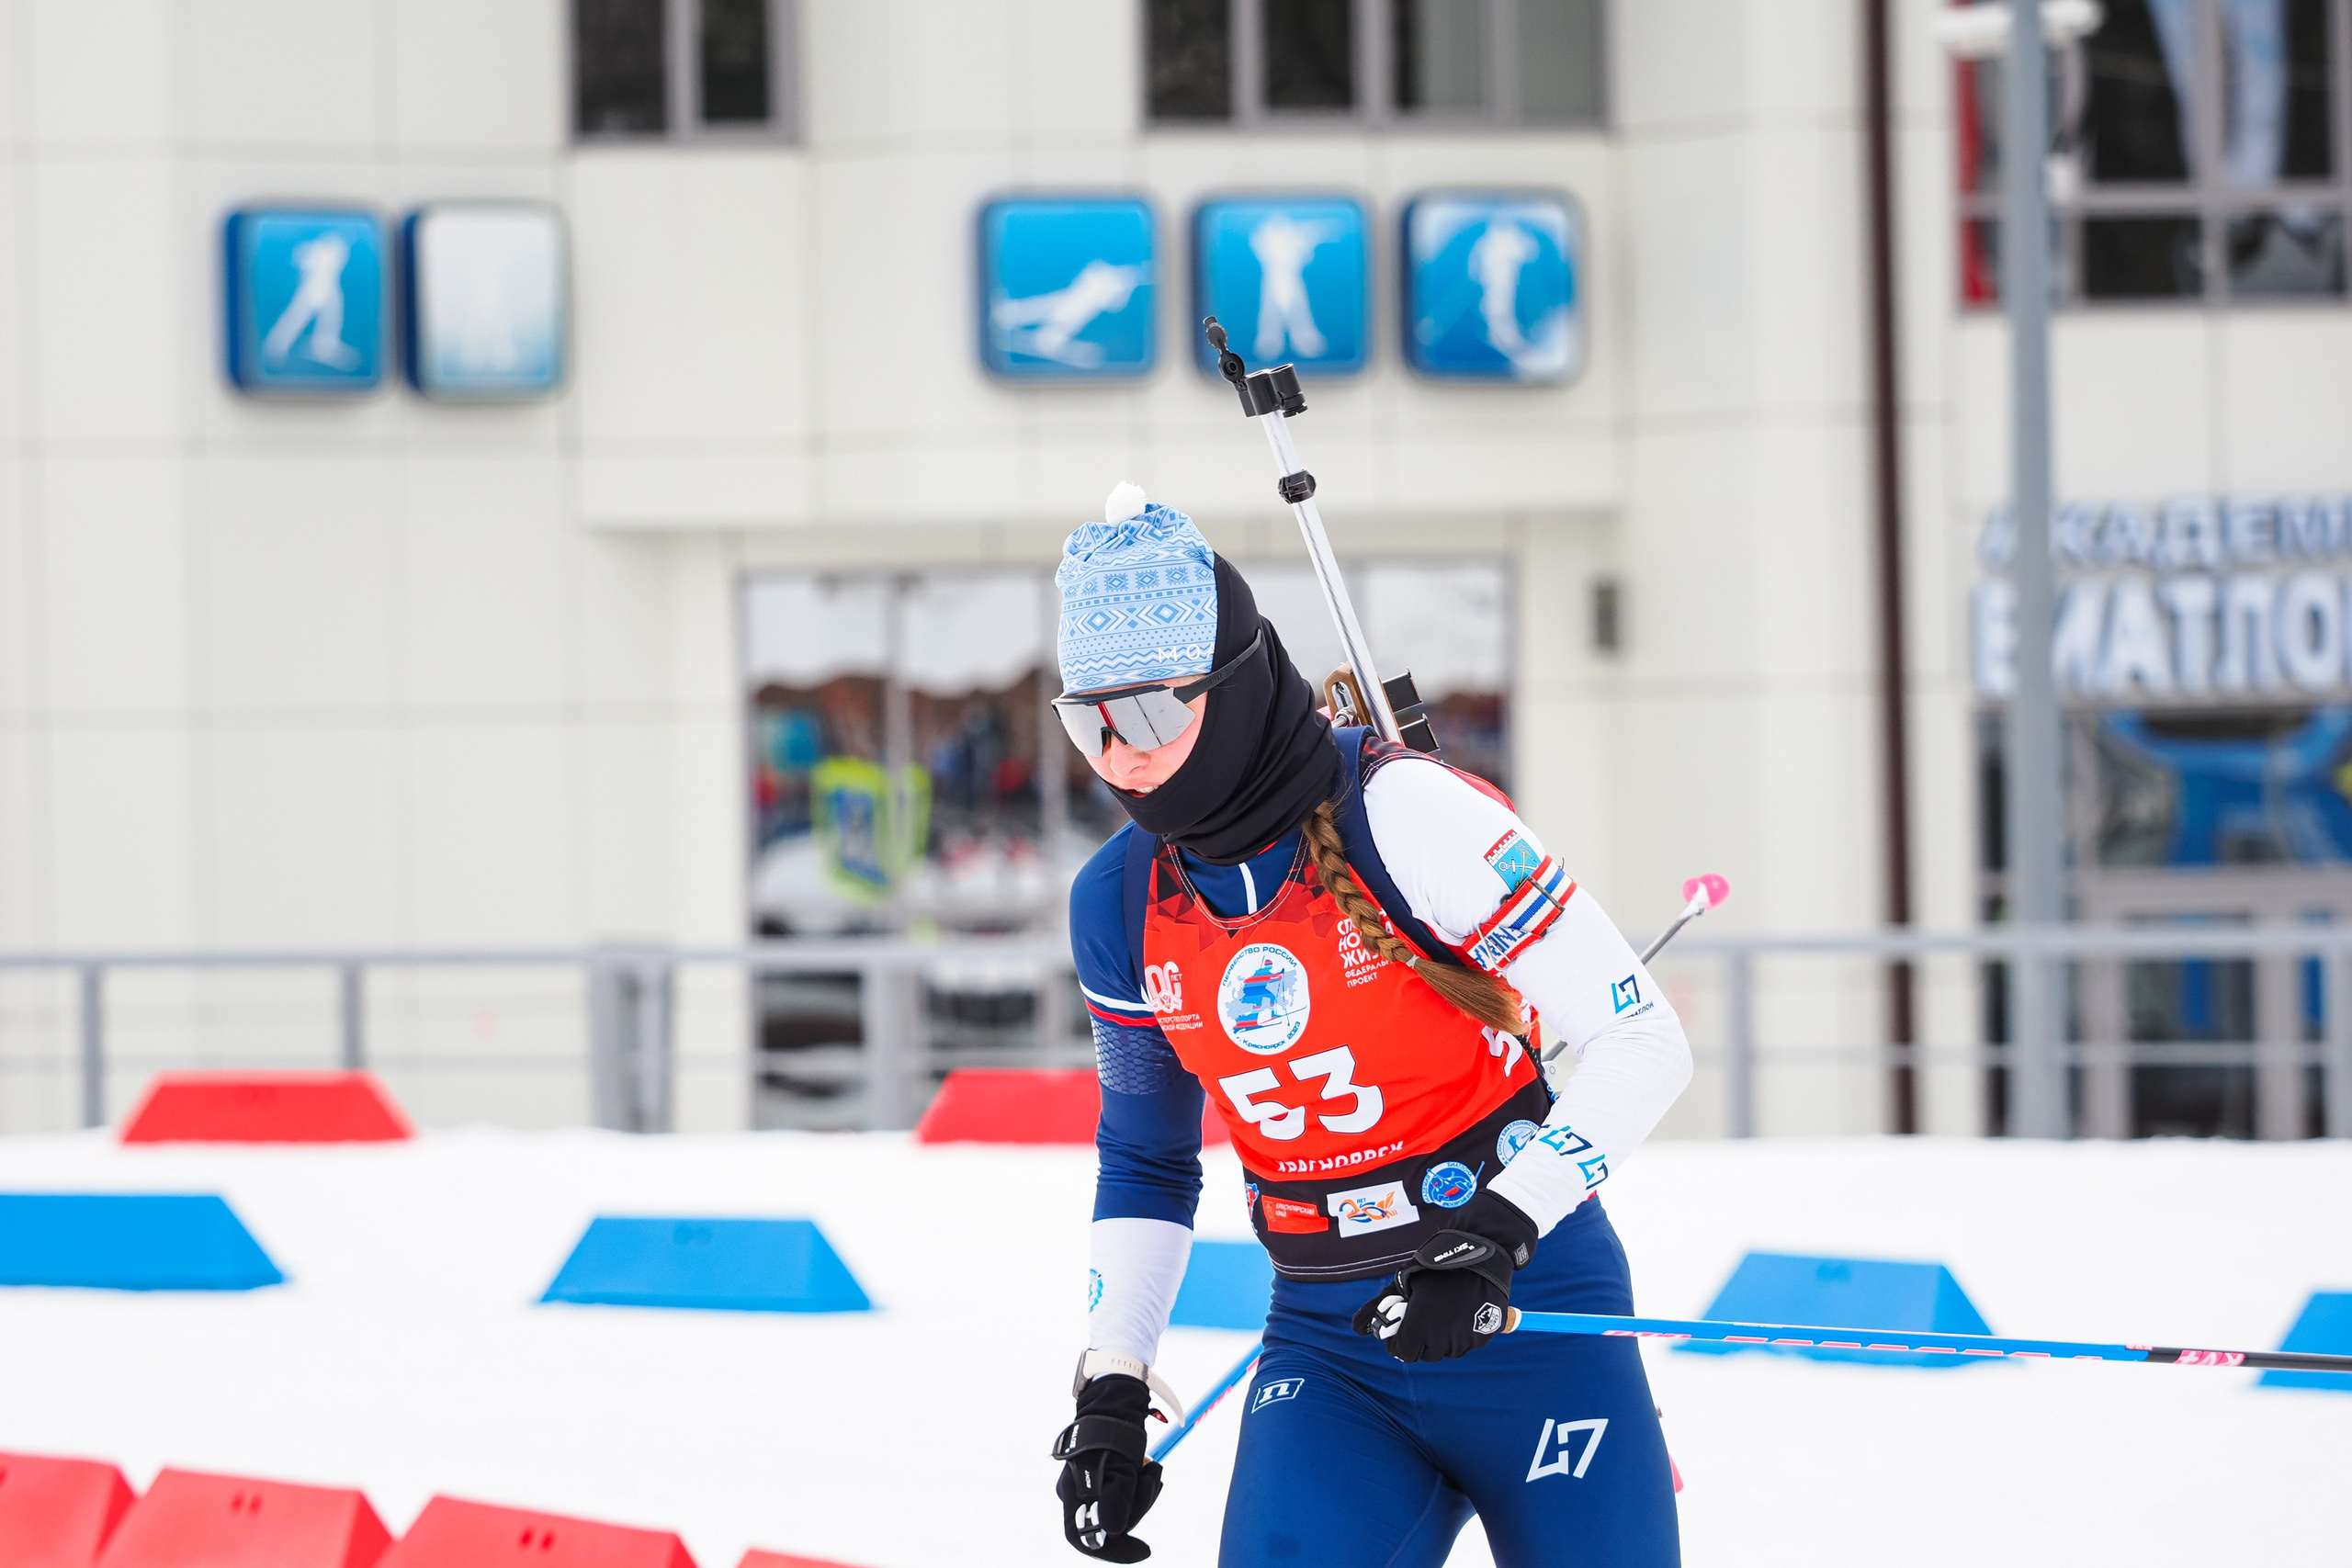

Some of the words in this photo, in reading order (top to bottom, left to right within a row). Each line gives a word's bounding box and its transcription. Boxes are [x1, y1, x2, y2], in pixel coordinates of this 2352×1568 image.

[1222, 946, 1261, 987] ПЕРВЕНСТВО
[1262, 946, 1297, 968] РОССИИ
[1347, 972, 1378, 988] ПРОЕКТ
[1627, 1001, 1655, 1018] АТЛОН
[1243, 1039, 1285, 1050] Красноярск
[1286, 1021, 1301, 1040] 2023
[1218, 1044, 1385, 1140] 53
[1502, 1121, 1538, 1137] БИАТЛОНИСТО
